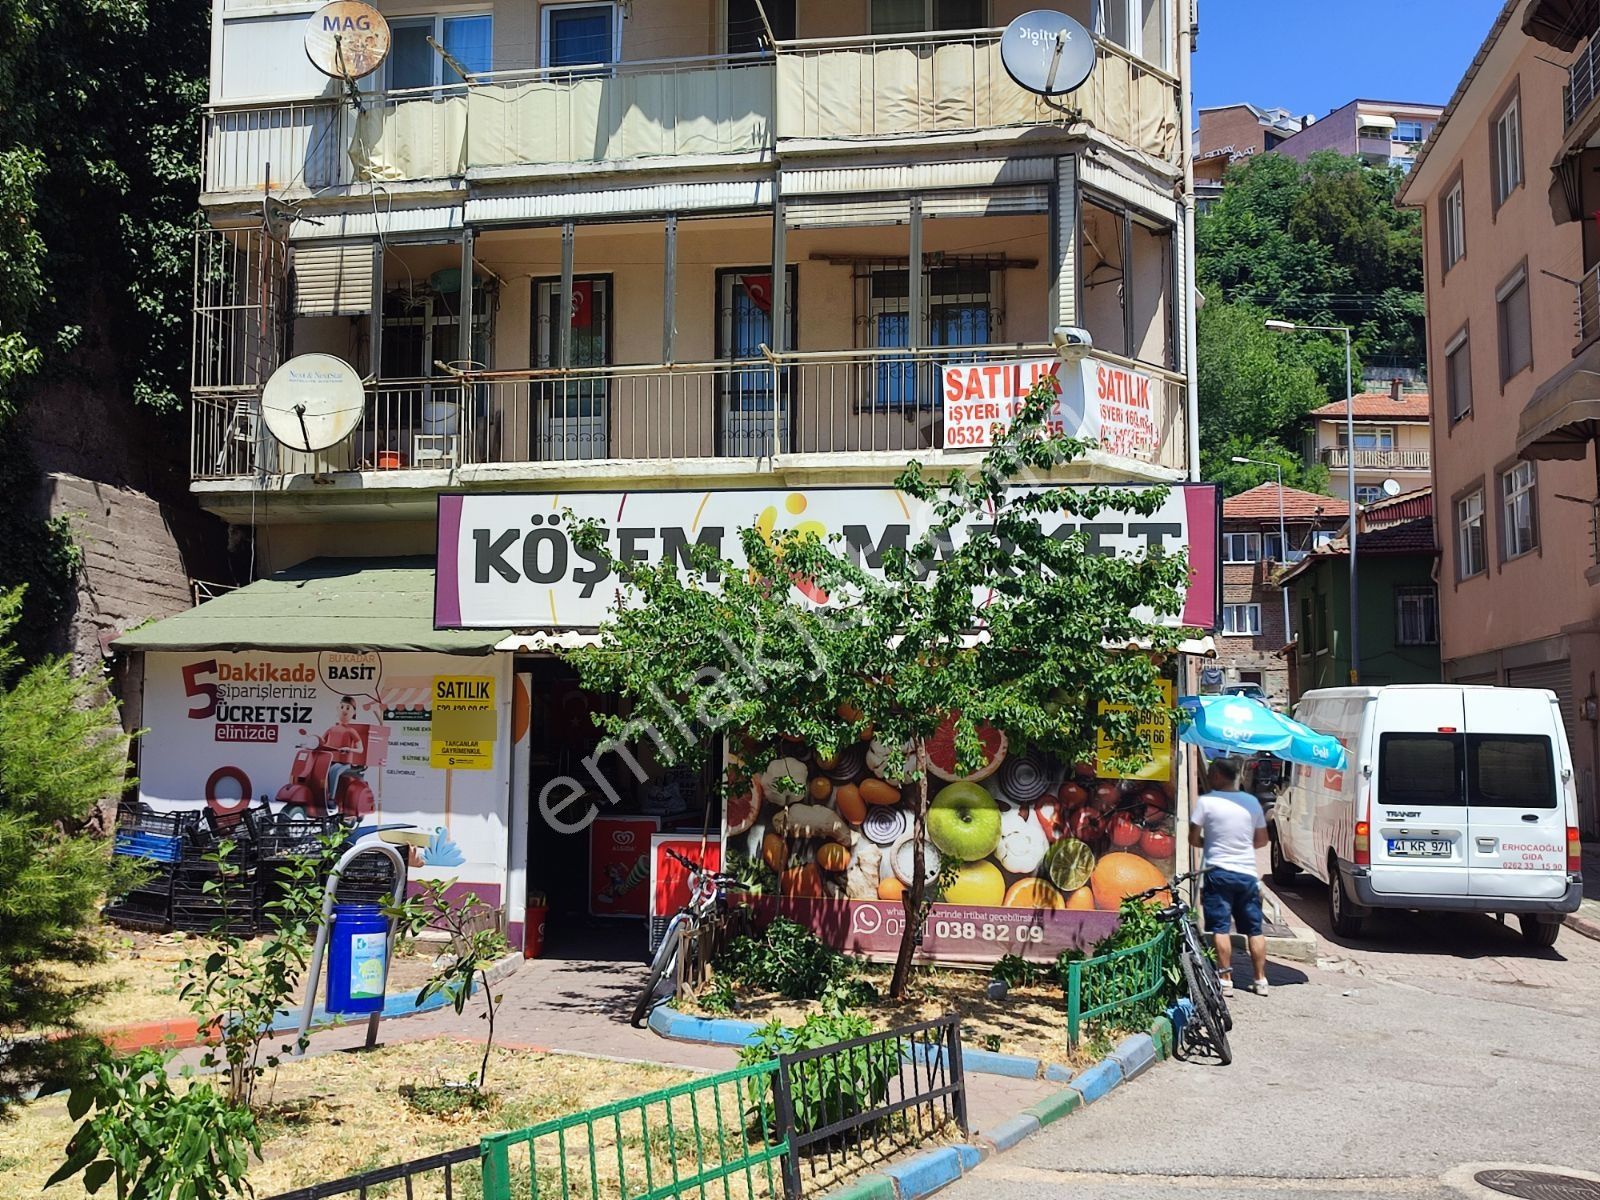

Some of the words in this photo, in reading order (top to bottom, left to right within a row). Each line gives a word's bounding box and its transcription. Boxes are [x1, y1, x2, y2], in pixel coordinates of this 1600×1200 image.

[323, 15, 370, 31] MAG
[946, 362, 1064, 402] SATILIK
[1097, 366, 1150, 410] SATILIK
[947, 425, 985, 446] 0532
[472, 513, 726, 599] KÖŞEM
[328, 654, 342, 663] BU
[343, 654, 376, 663] KADAR
[218, 662, 316, 682] Dakikada
[328, 663, 376, 680] BASİT
[182, 659, 218, 720] 5
[216, 683, 317, 701] Siparişleriniz
[437, 681, 490, 700] SATILIK
[216, 701, 313, 724] ÜCRETSİZ
[217, 726, 276, 741] elinizde
[1386, 810, 1421, 818] TRANSIT
[1395, 840, 1405, 851] 41
[1410, 840, 1426, 851] KR
[1431, 841, 1449, 852] 971
[1521, 853, 1543, 861] GIDA
[935, 920, 976, 939] 038
[981, 923, 1010, 942] 82
[1015, 924, 1044, 943] 09
